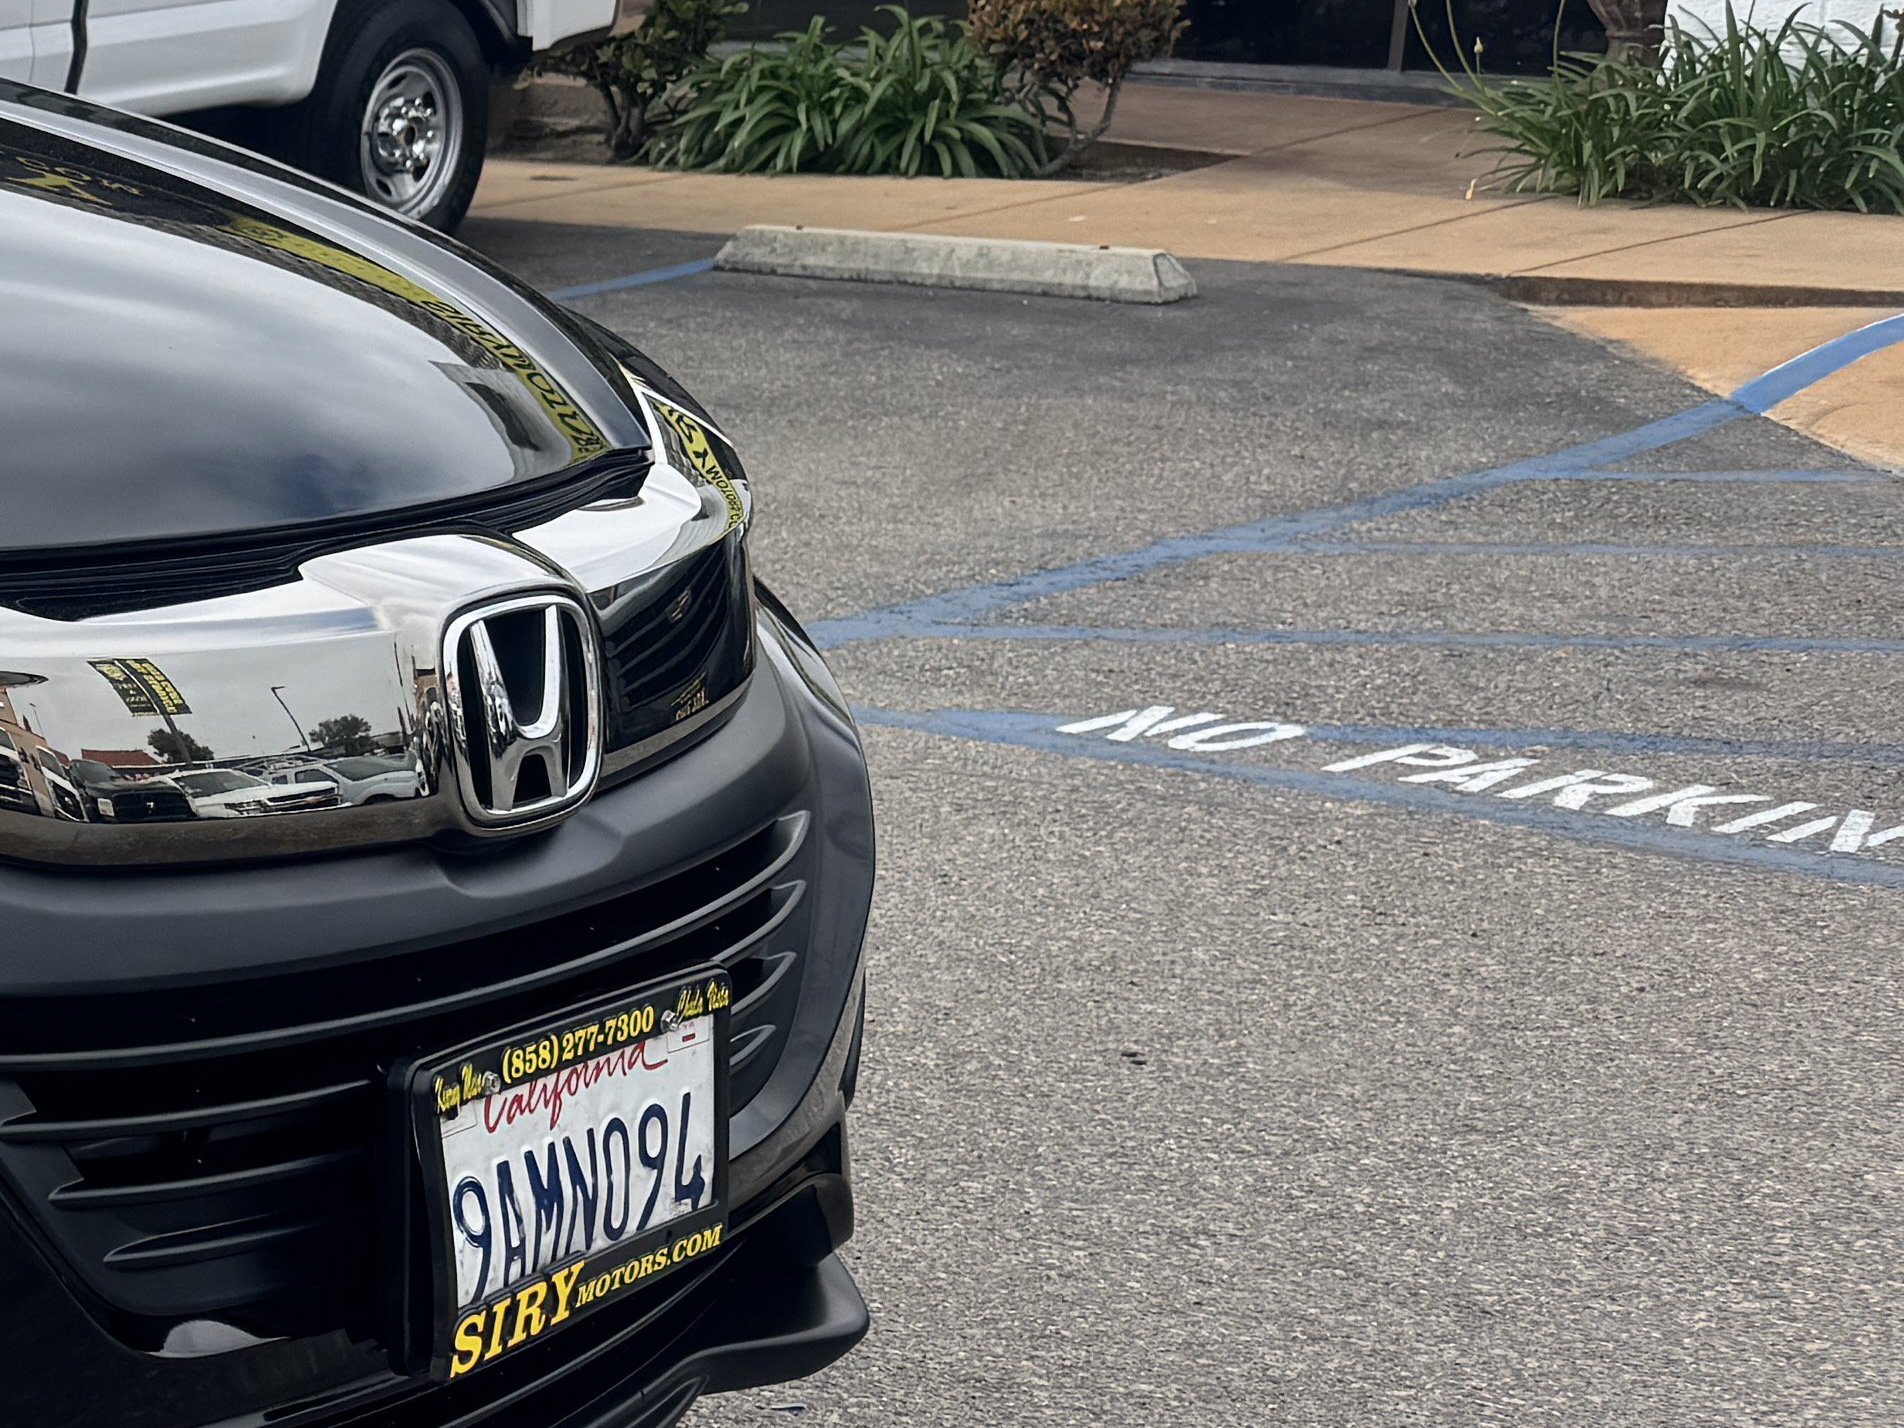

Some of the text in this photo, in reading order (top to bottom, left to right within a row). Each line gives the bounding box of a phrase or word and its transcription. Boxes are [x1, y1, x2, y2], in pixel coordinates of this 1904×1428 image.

[1055, 705, 1308, 752] NO
[484, 1040, 669, 1133] California
[502, 1035, 559, 1084] (858)
[562, 1005, 655, 1061] 277-7300
[452, 1091, 707, 1305] 9AMN094
[449, 1222, 724, 1380] SIRY MOTORS.COM
